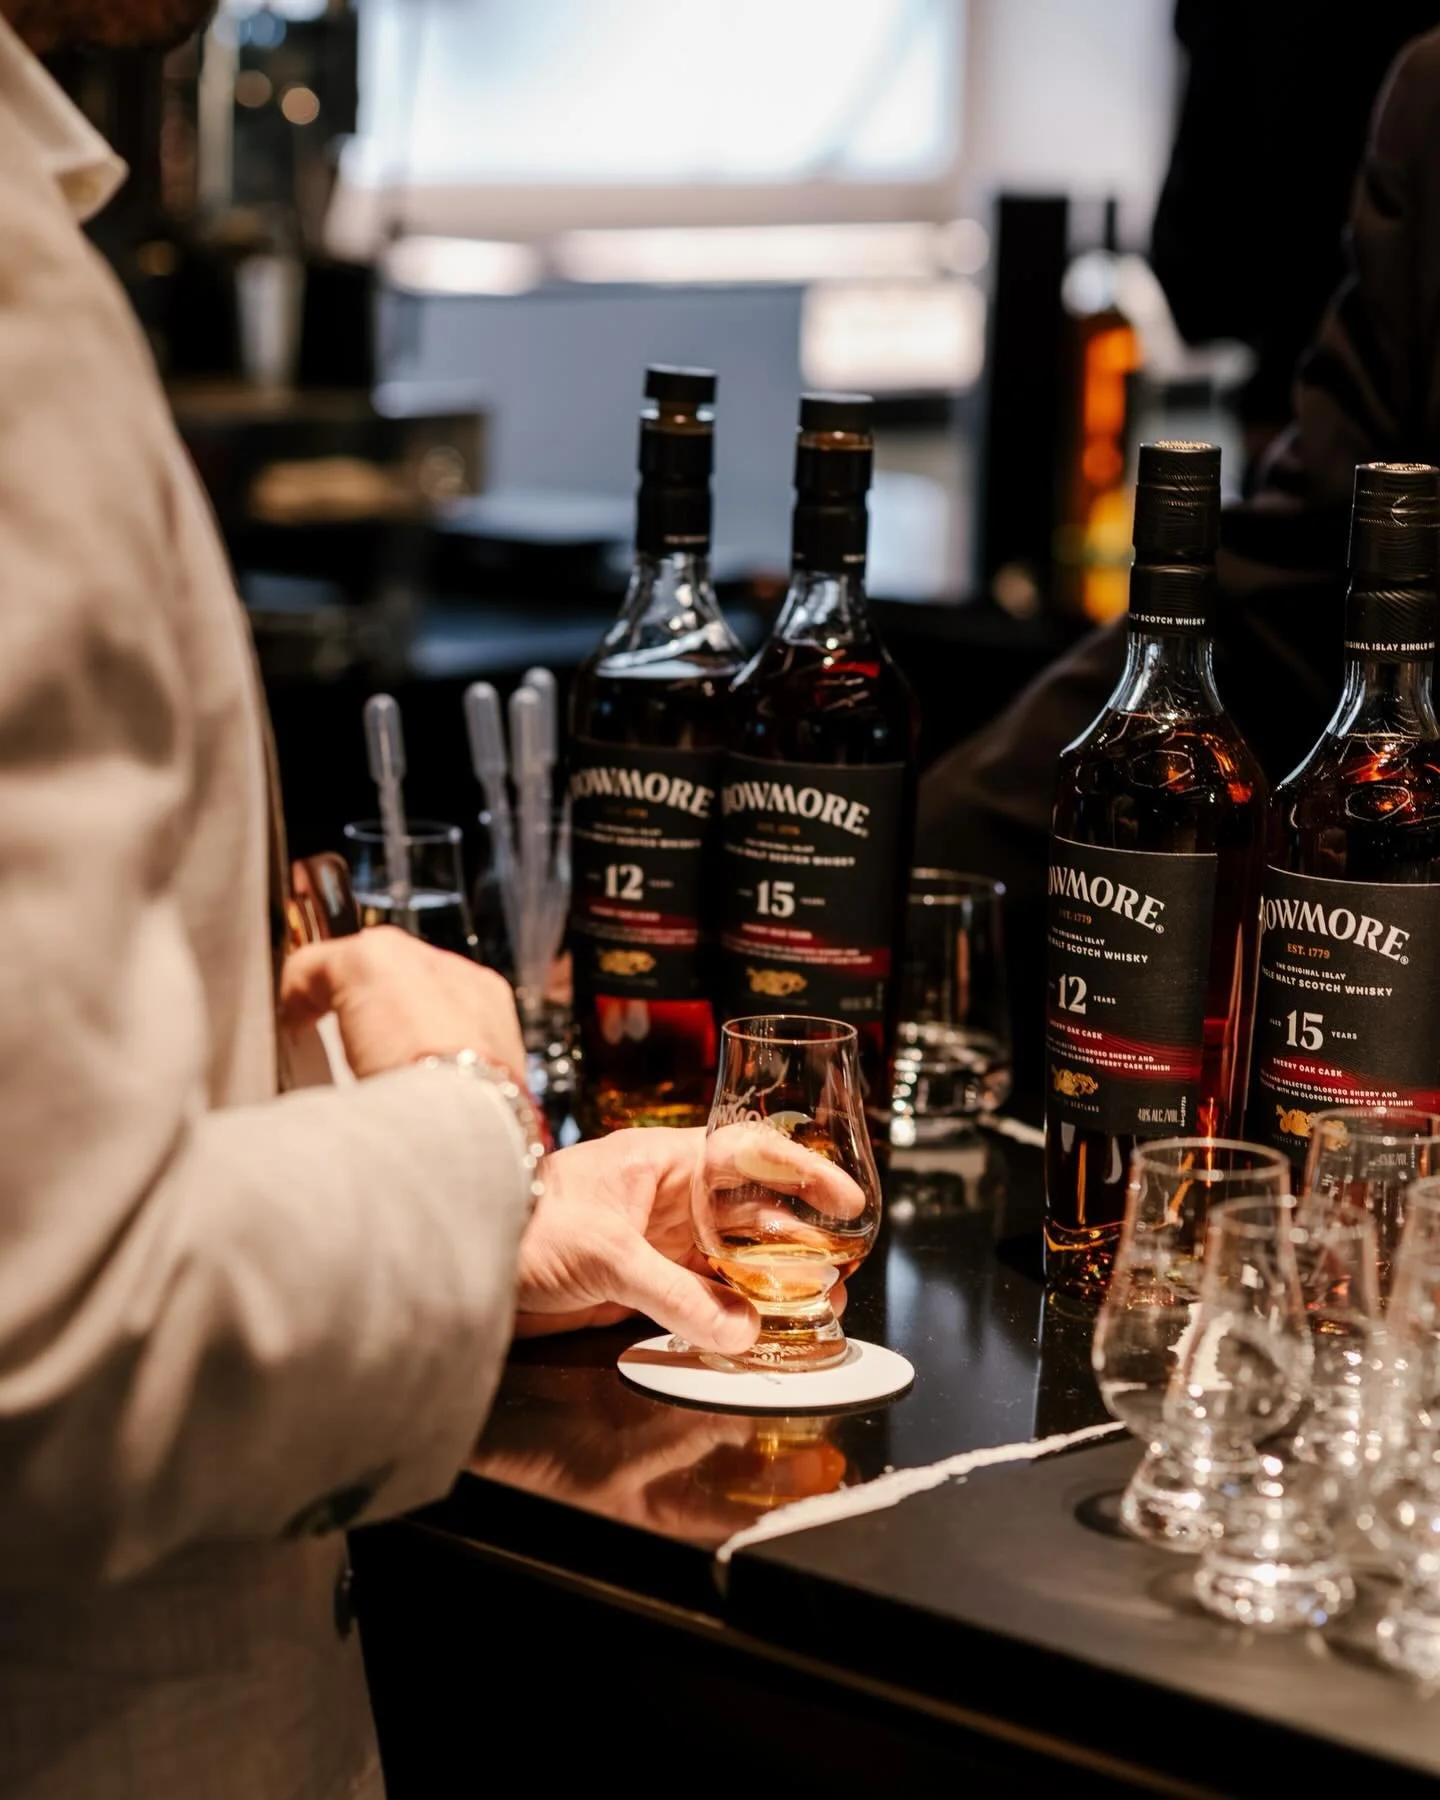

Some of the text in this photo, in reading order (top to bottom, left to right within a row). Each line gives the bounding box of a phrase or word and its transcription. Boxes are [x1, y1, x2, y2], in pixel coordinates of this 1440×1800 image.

[1140, 614, 1173, 625] SCOTCH
[1175, 617, 1206, 626] WHISKY
[1372, 642, 1398, 652] ISLAY
[1401, 643, 1428, 652] SINGLE
[605, 863, 645, 901] 12
[756, 879, 797, 918] 15
[1048, 865, 1165, 931] OWMORE
[1085, 935, 1106, 946] ISLAY
[1066, 942, 1101, 959] SCOTCH
[1104, 950, 1149, 964] WHISKY
[1287, 943, 1331, 960] EST. 1779
[1286, 964, 1320, 978] ORIGINAL
[1322, 970, 1347, 981] ISLAY
[1058, 973, 1117, 1015] 12 YEARS
[1275, 973, 1297, 986] MALT
[1298, 979, 1341, 994] SCOTCH
[1345, 985, 1393, 997] WHISKY
[1066, 1026, 1081, 1036] OAK
[1081, 1029, 1103, 1040] CASK
[1286, 1009, 1324, 1051] 15
[1331, 1030, 1358, 1040] YEARS
[1096, 1058, 1122, 1069] SHERRY
[1123, 1062, 1143, 1071] CASK
[1145, 1063, 1171, 1072] FINISH
[1109, 1051, 1136, 1061] SHERRY
[1138, 1055, 1154, 1063] AND
[1273, 1057, 1343, 1078] SHERRY OAK CASK
[1282, 1079, 1312, 1091] SELECTED
[1313, 1085, 1348, 1096] OLOROSO
[1350, 1089, 1380, 1098] SHERRY
[1300, 1091, 1333, 1103] OLOROSO
[1334, 1097, 1364, 1106] SHERRY
[1366, 1099, 1387, 1107] CASK
[1388, 1099, 1414, 1108] FINISH
